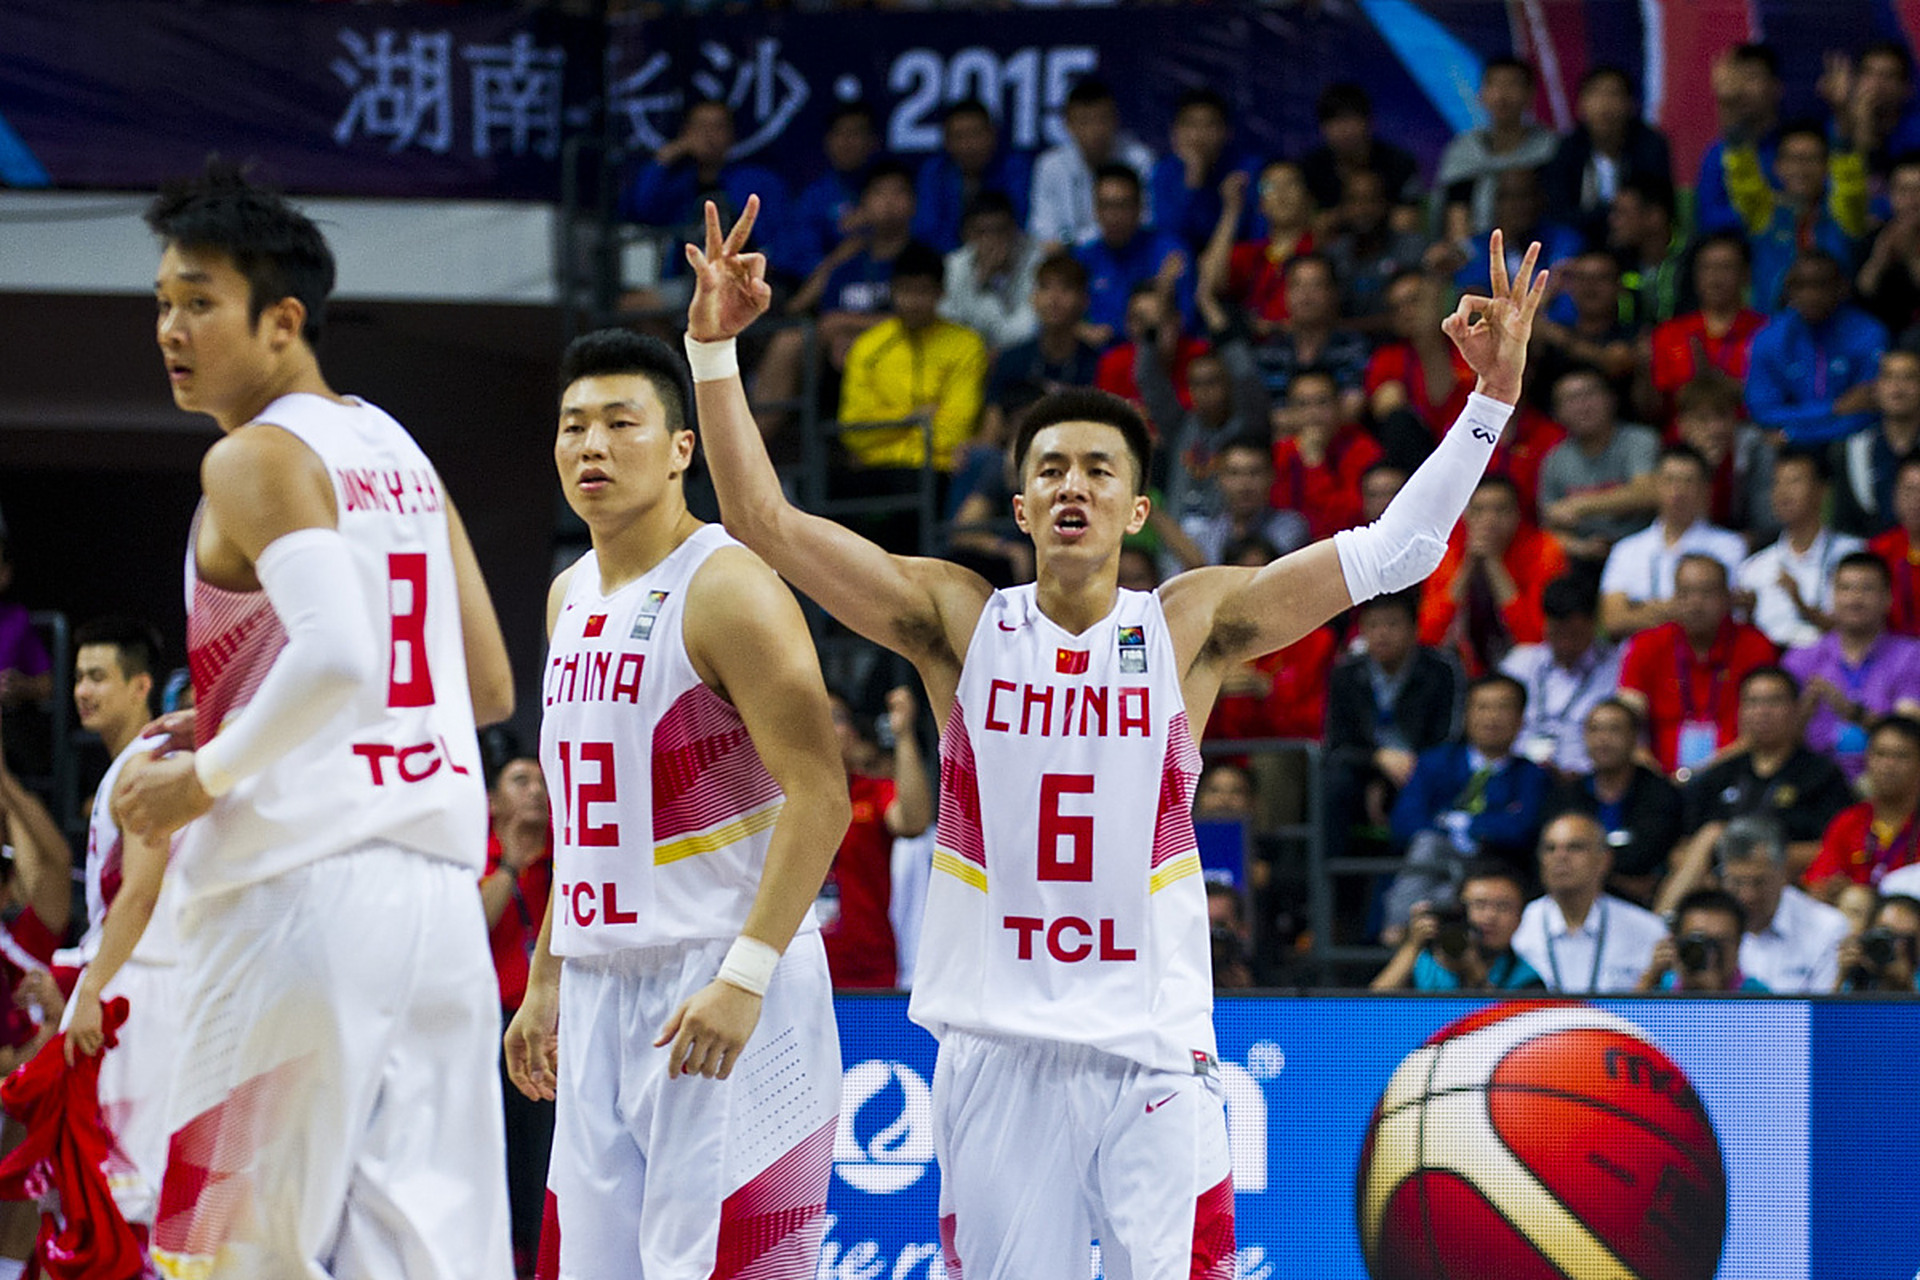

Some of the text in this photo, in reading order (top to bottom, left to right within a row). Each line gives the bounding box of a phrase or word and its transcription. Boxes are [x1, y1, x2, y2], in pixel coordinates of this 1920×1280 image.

[887, 46, 1098, 151] 2015
[386, 553, 436, 708] 8
[546, 651, 646, 707] CHINA
[985, 678, 1151, 738] CHINA
[352, 734, 470, 786] TCL
[558, 741, 619, 847] 12
[1037, 773, 1094, 882] 6
[562, 881, 638, 927] TCL
[1003, 915, 1137, 963] TCL
